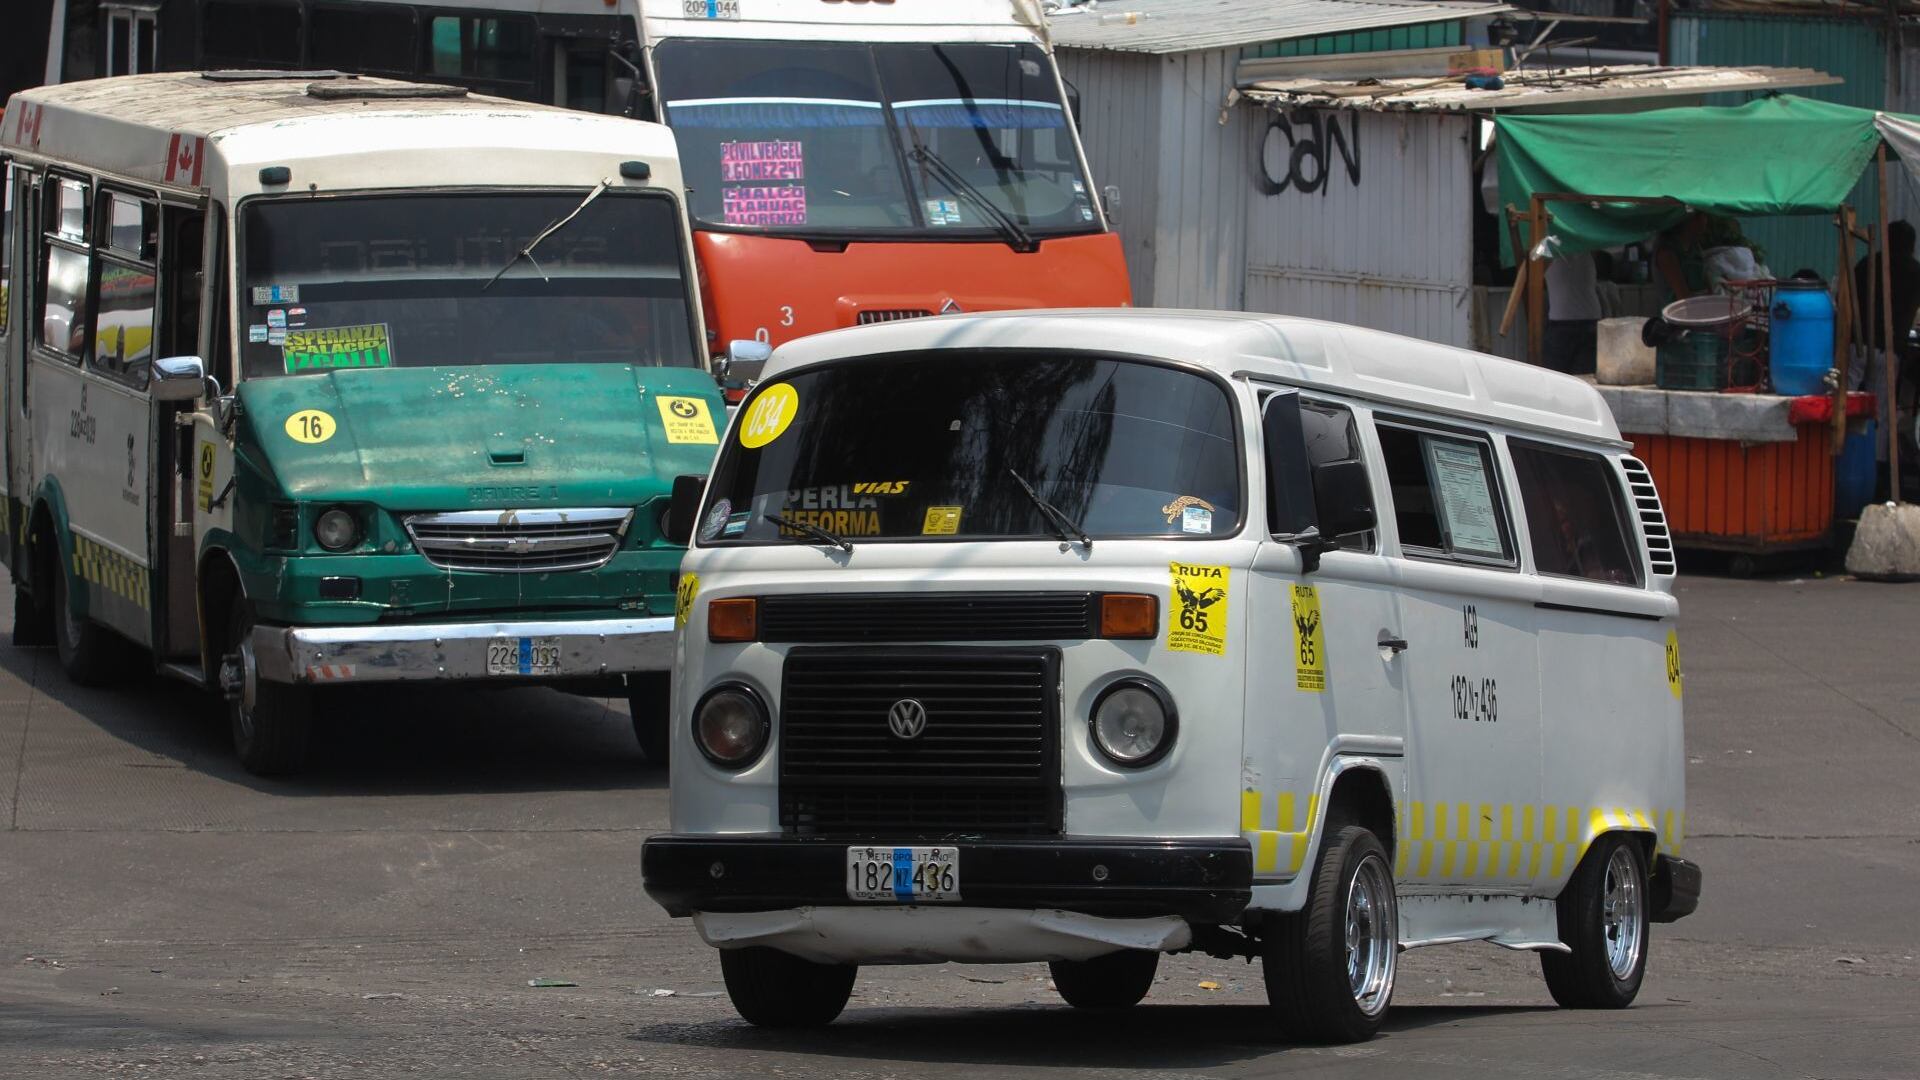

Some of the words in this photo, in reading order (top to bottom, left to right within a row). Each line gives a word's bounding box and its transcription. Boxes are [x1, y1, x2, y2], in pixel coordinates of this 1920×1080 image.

[685, 0, 707, 13] 209
[716, 1, 738, 14] 044
[723, 187, 804, 200] CHALCO
[724, 200, 805, 213] TLAHUAC
[780, 305, 794, 327] 3
[284, 325, 385, 346] ESPERANZA
[747, 394, 788, 437] 034
[785, 484, 878, 509] PERLA
[853, 480, 910, 495] VIAS
[780, 510, 881, 536] REFORMA
[1179, 566, 1222, 578] RUTA
[1295, 586, 1314, 598] RUTA
[1180, 609, 1208, 632] 65
[1463, 604, 1479, 649] AG9
[490, 646, 518, 665] 226
[531, 646, 559, 666] 039
[1300, 640, 1315, 666] 65
[852, 861, 893, 892] 182
[912, 861, 954, 892] 436
